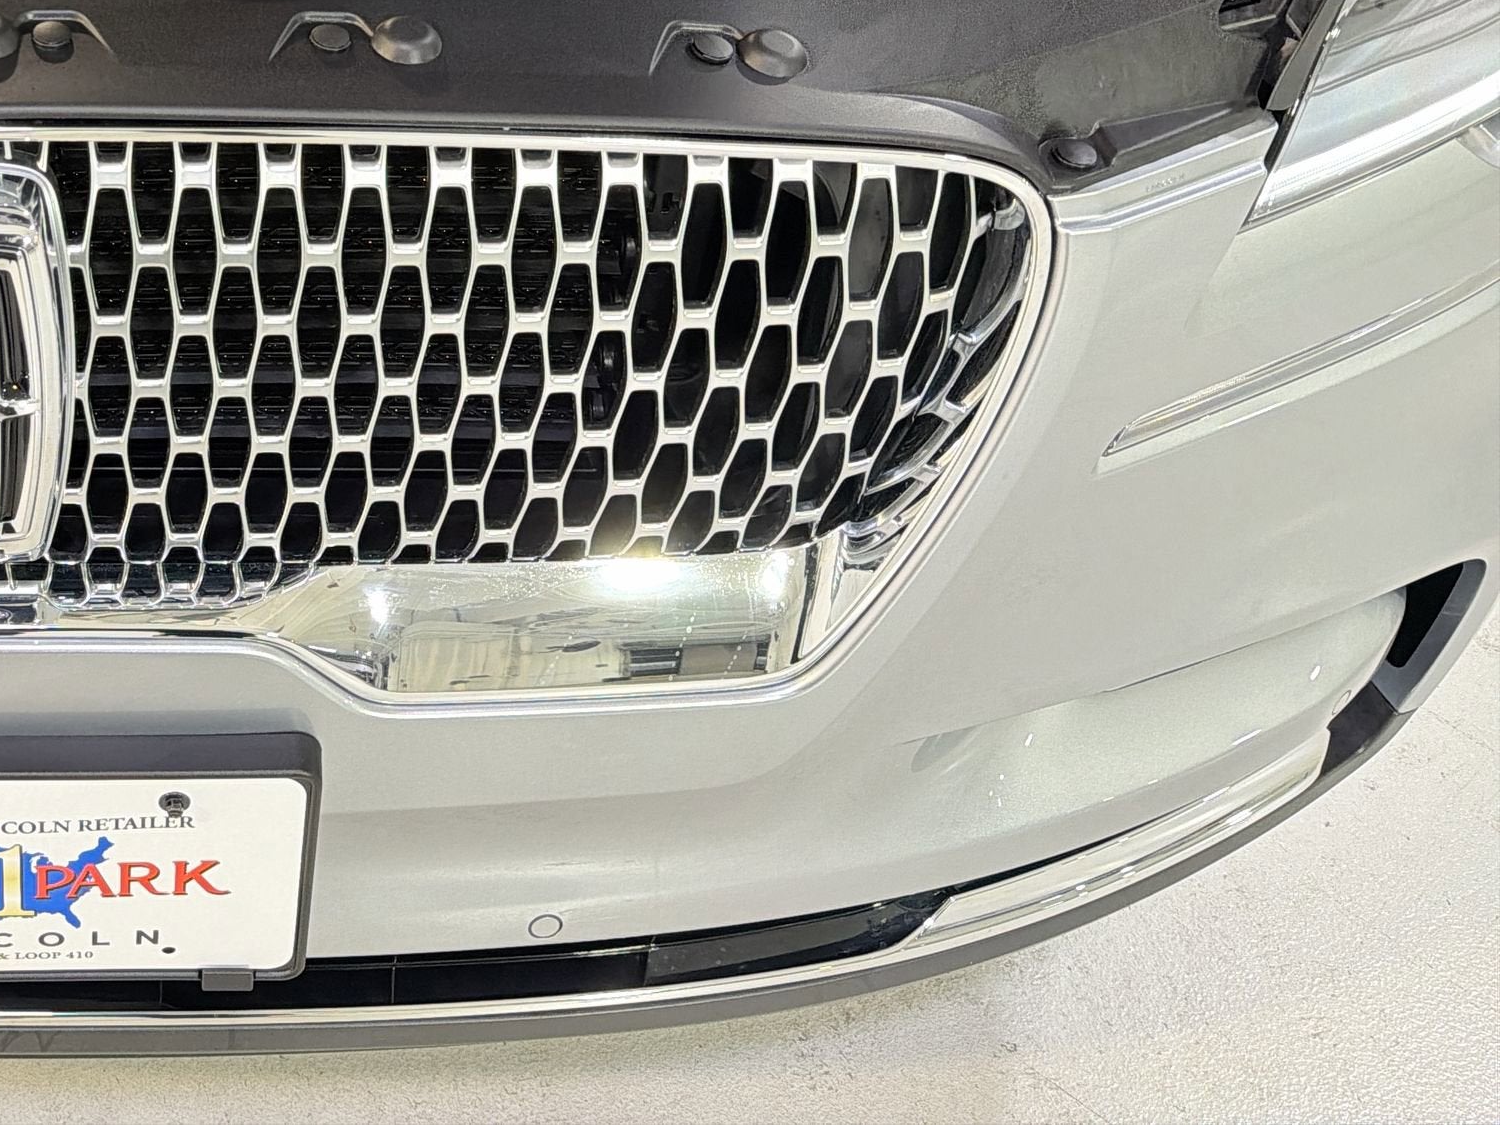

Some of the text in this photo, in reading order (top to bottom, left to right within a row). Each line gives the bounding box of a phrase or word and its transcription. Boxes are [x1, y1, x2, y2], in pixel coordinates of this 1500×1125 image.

[77, 815, 196, 832] RETAILER
[34, 859, 232, 900] PARK
[15, 951, 62, 960] LOOP
[66, 951, 94, 959] 410
